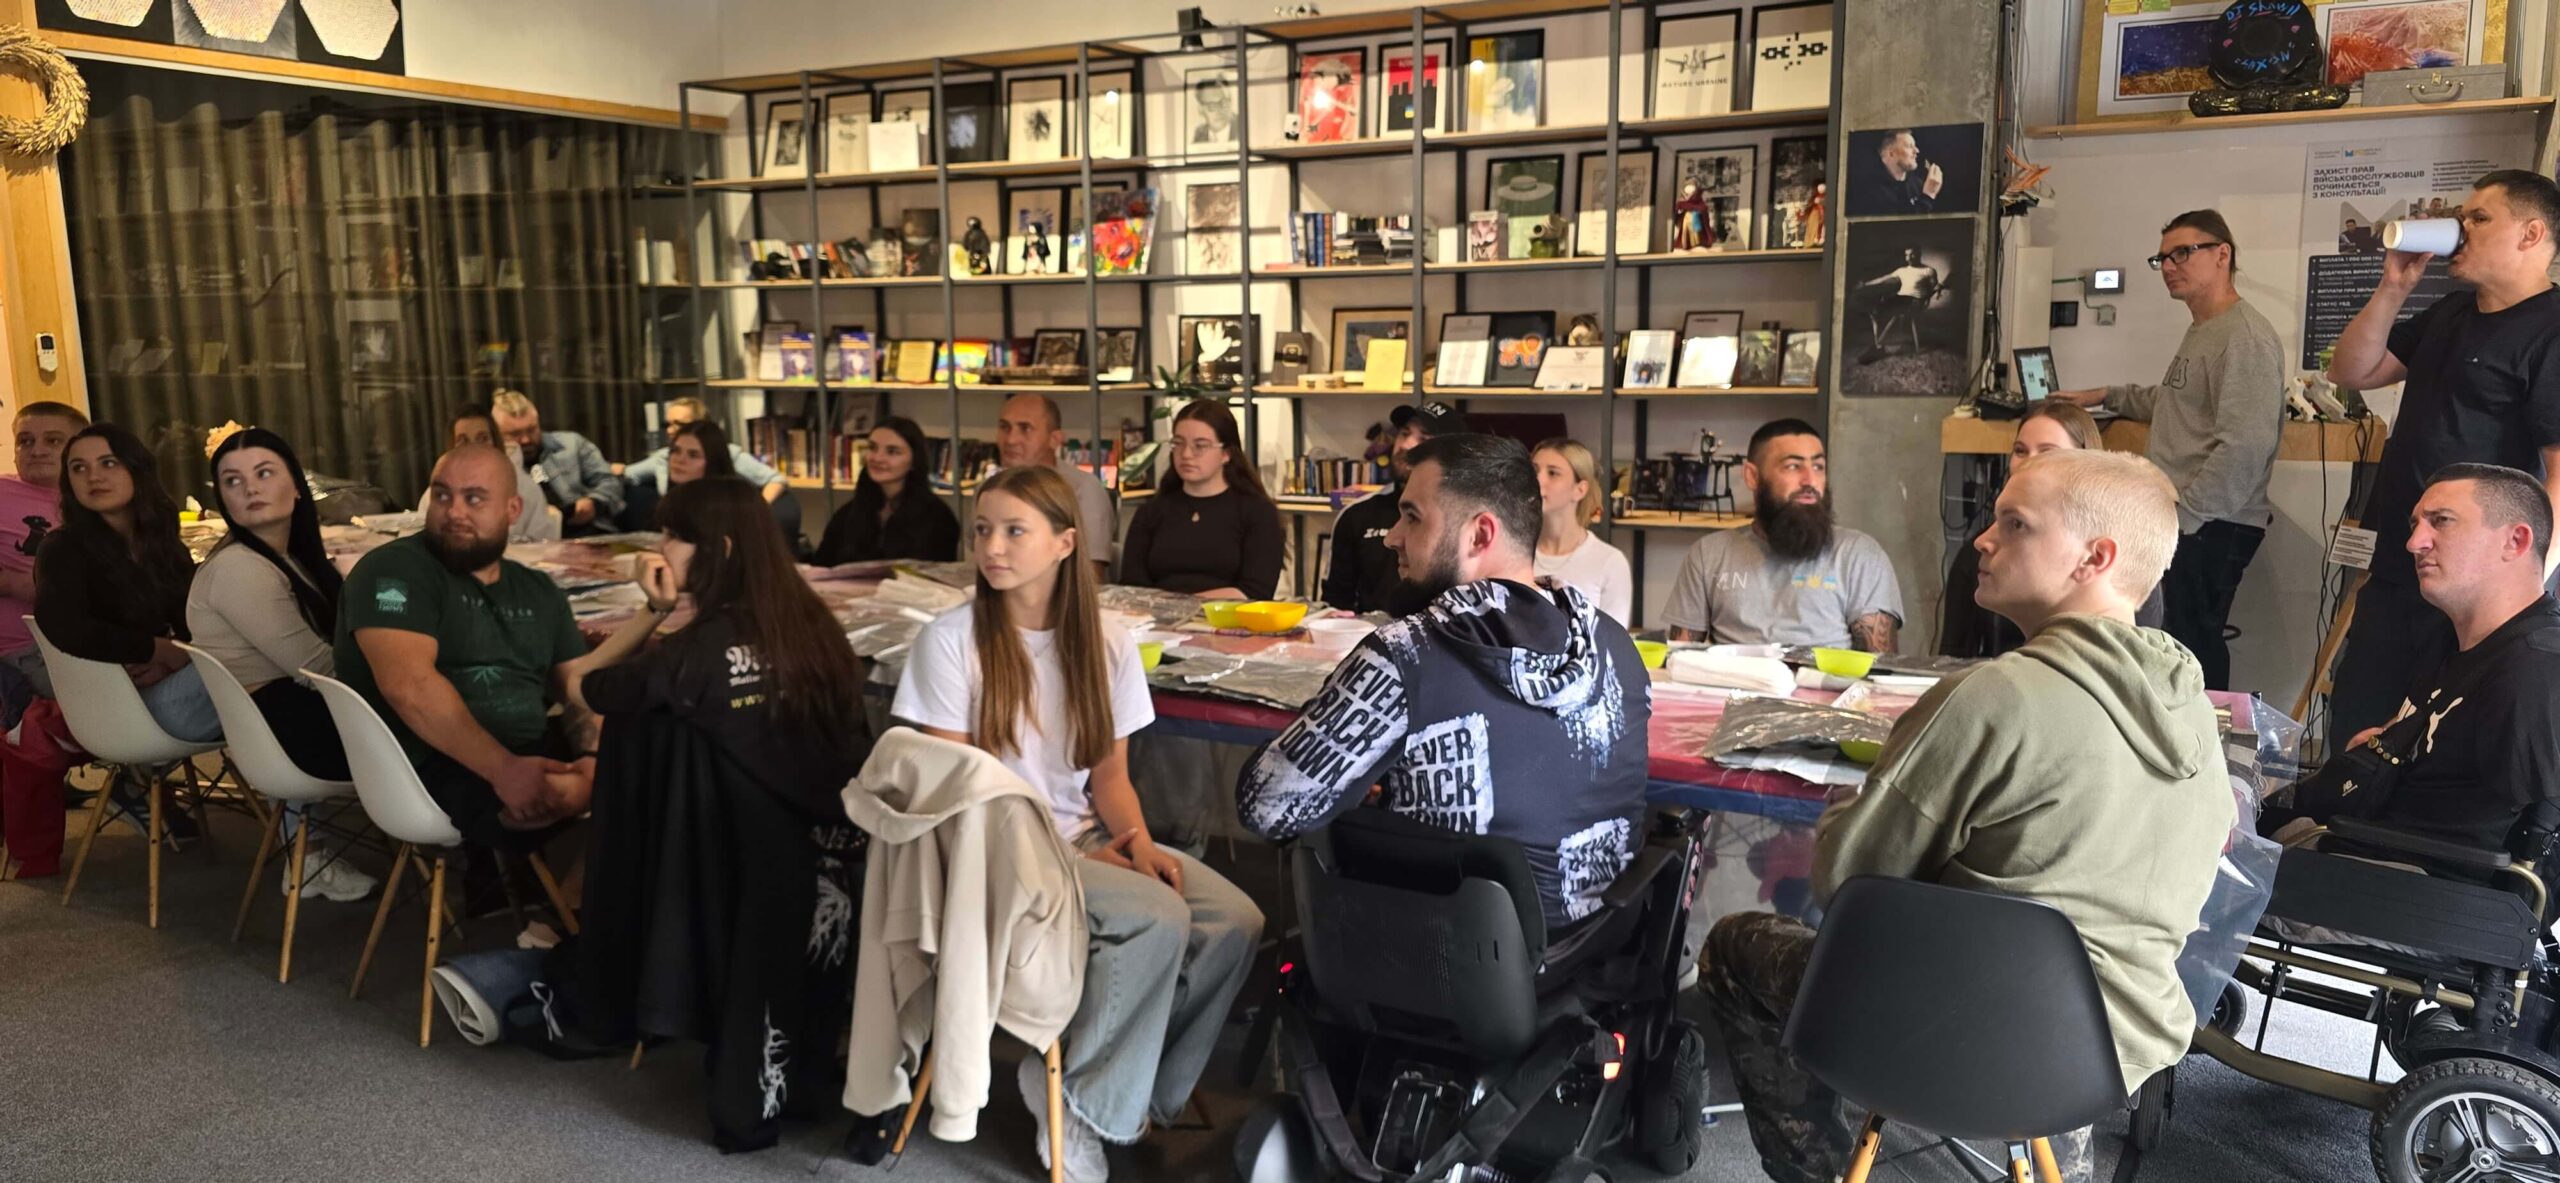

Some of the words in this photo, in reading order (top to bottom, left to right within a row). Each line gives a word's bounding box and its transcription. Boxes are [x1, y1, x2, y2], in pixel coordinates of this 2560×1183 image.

[2313, 170, 2425, 183] ВІЙСЬКОВОСЛУЖБОВЦІВ
[2313, 181, 2380, 191] ПОЧИНАЄТЬСЯ
[2314, 167, 2349, 176] ЗАХИСТ
[1337, 654, 1408, 722] NEVER
[1308, 684, 1390, 757] BACK
[1278, 719, 1356, 787] DOWN
[1399, 764, 1477, 808] BACK
